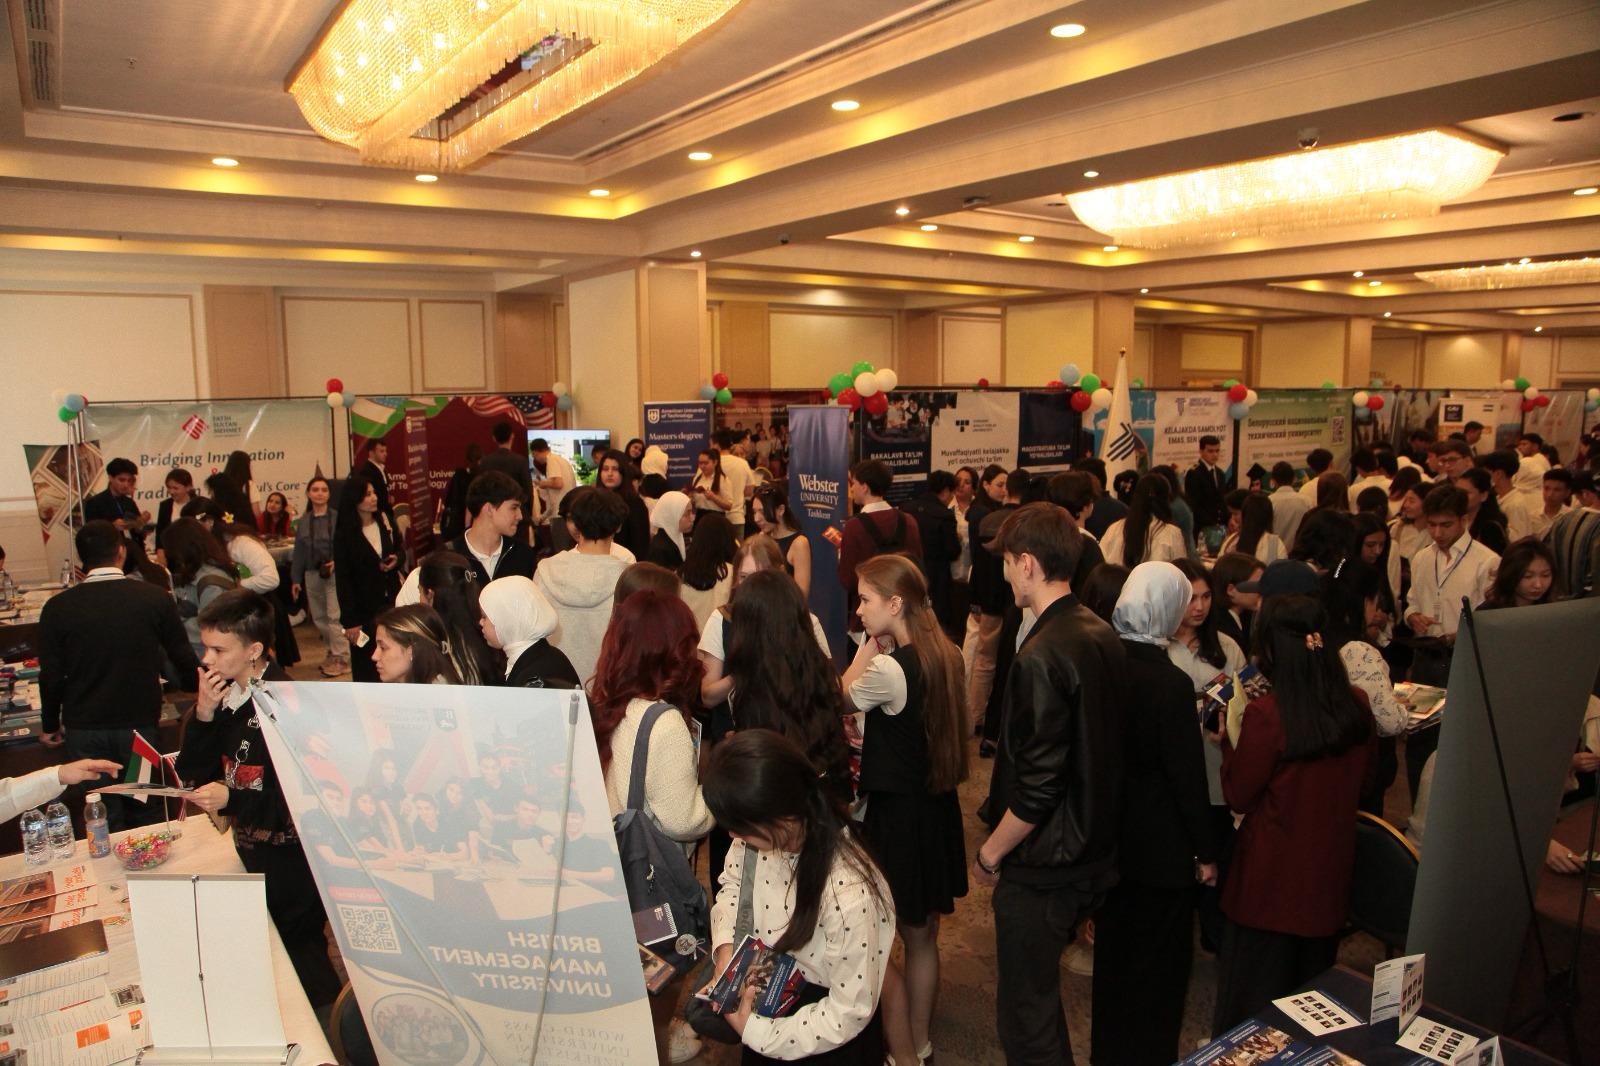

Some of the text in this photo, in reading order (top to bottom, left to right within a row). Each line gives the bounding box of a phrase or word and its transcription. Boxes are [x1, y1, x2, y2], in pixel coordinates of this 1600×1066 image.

[140, 449, 285, 469] Bridging Innation
[276, 481, 300, 492] Core
[799, 473, 840, 494] Webster
[800, 492, 839, 506] UNIVERSITY
[807, 508, 832, 520] Tashkent
